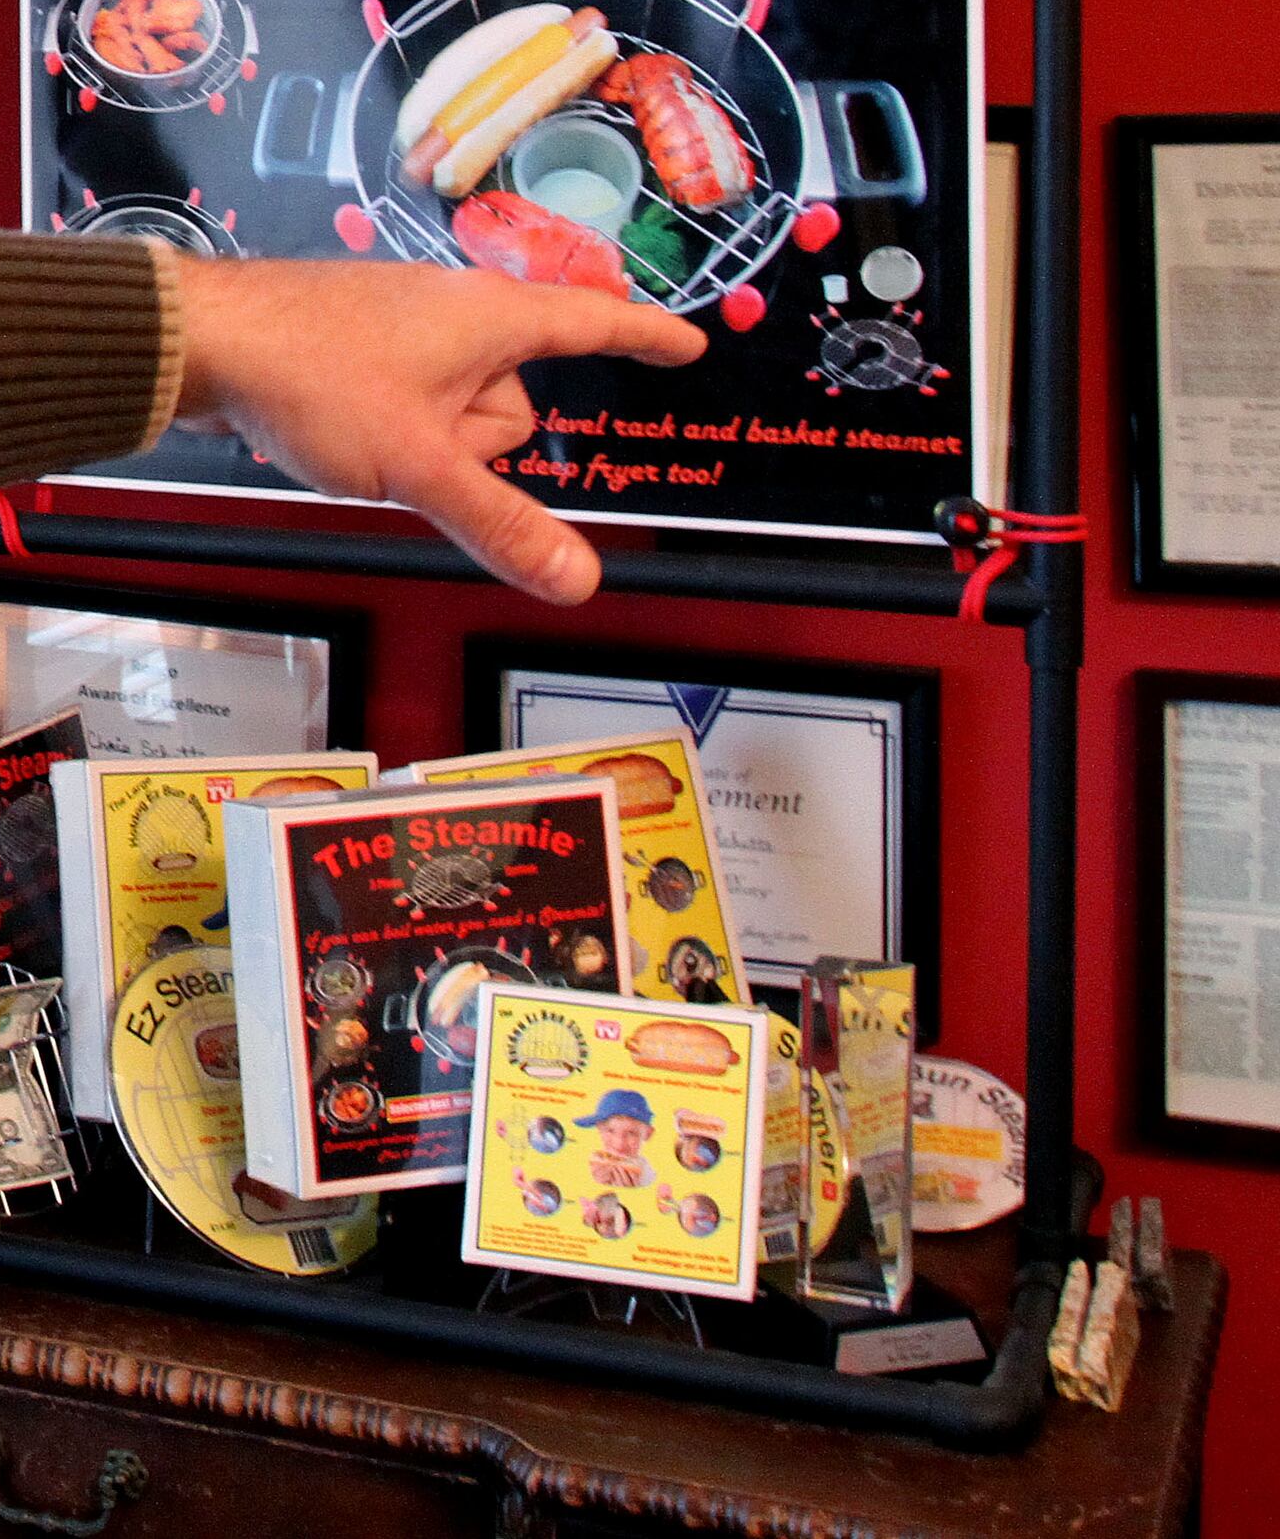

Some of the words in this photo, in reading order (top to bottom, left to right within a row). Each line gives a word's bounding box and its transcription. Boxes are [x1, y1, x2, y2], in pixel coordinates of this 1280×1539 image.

[612, 413, 676, 438] rack
[683, 415, 742, 441] and
[745, 416, 838, 446] basket
[844, 428, 963, 455] steamer
[493, 457, 511, 474] a
[517, 450, 580, 489] deep
[582, 453, 660, 493] fryer
[667, 460, 724, 487] too!
[312, 832, 397, 879] The
[407, 817, 577, 858] Steamie
